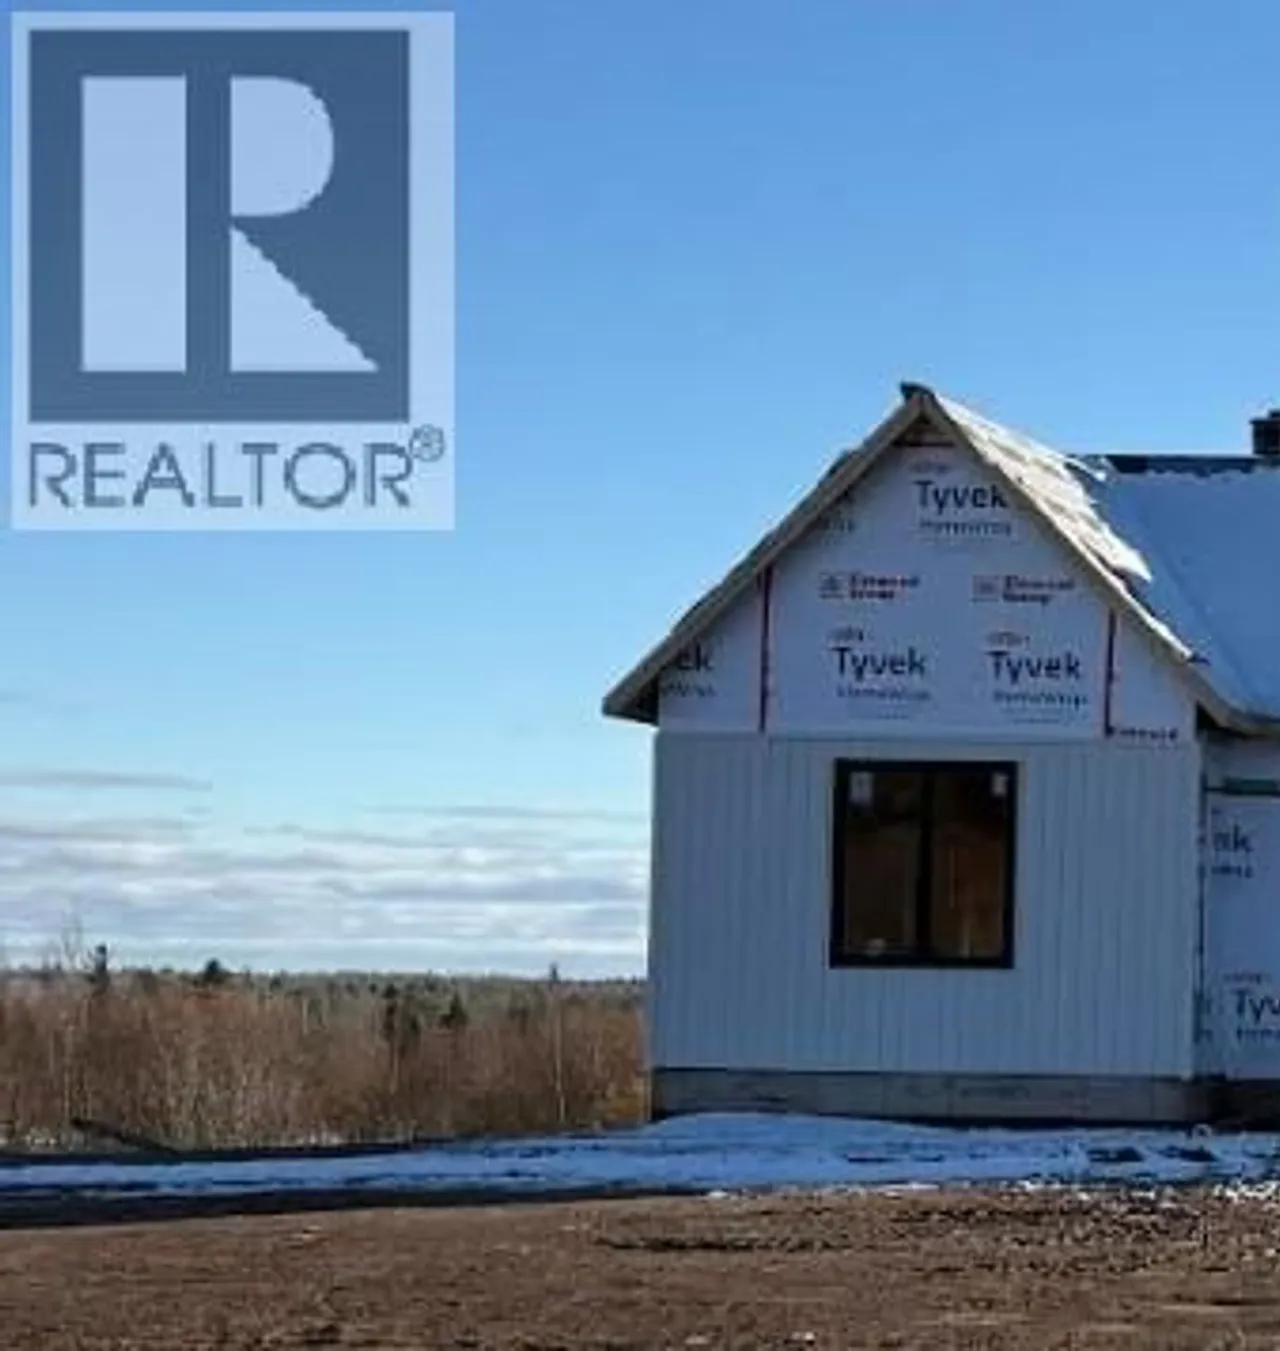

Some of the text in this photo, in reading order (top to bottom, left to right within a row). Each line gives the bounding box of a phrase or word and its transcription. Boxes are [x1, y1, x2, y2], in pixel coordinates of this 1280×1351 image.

[914, 480, 1008, 516] Tyvek
[832, 646, 926, 681] Tyvek
[986, 650, 1081, 685] Tyvek
